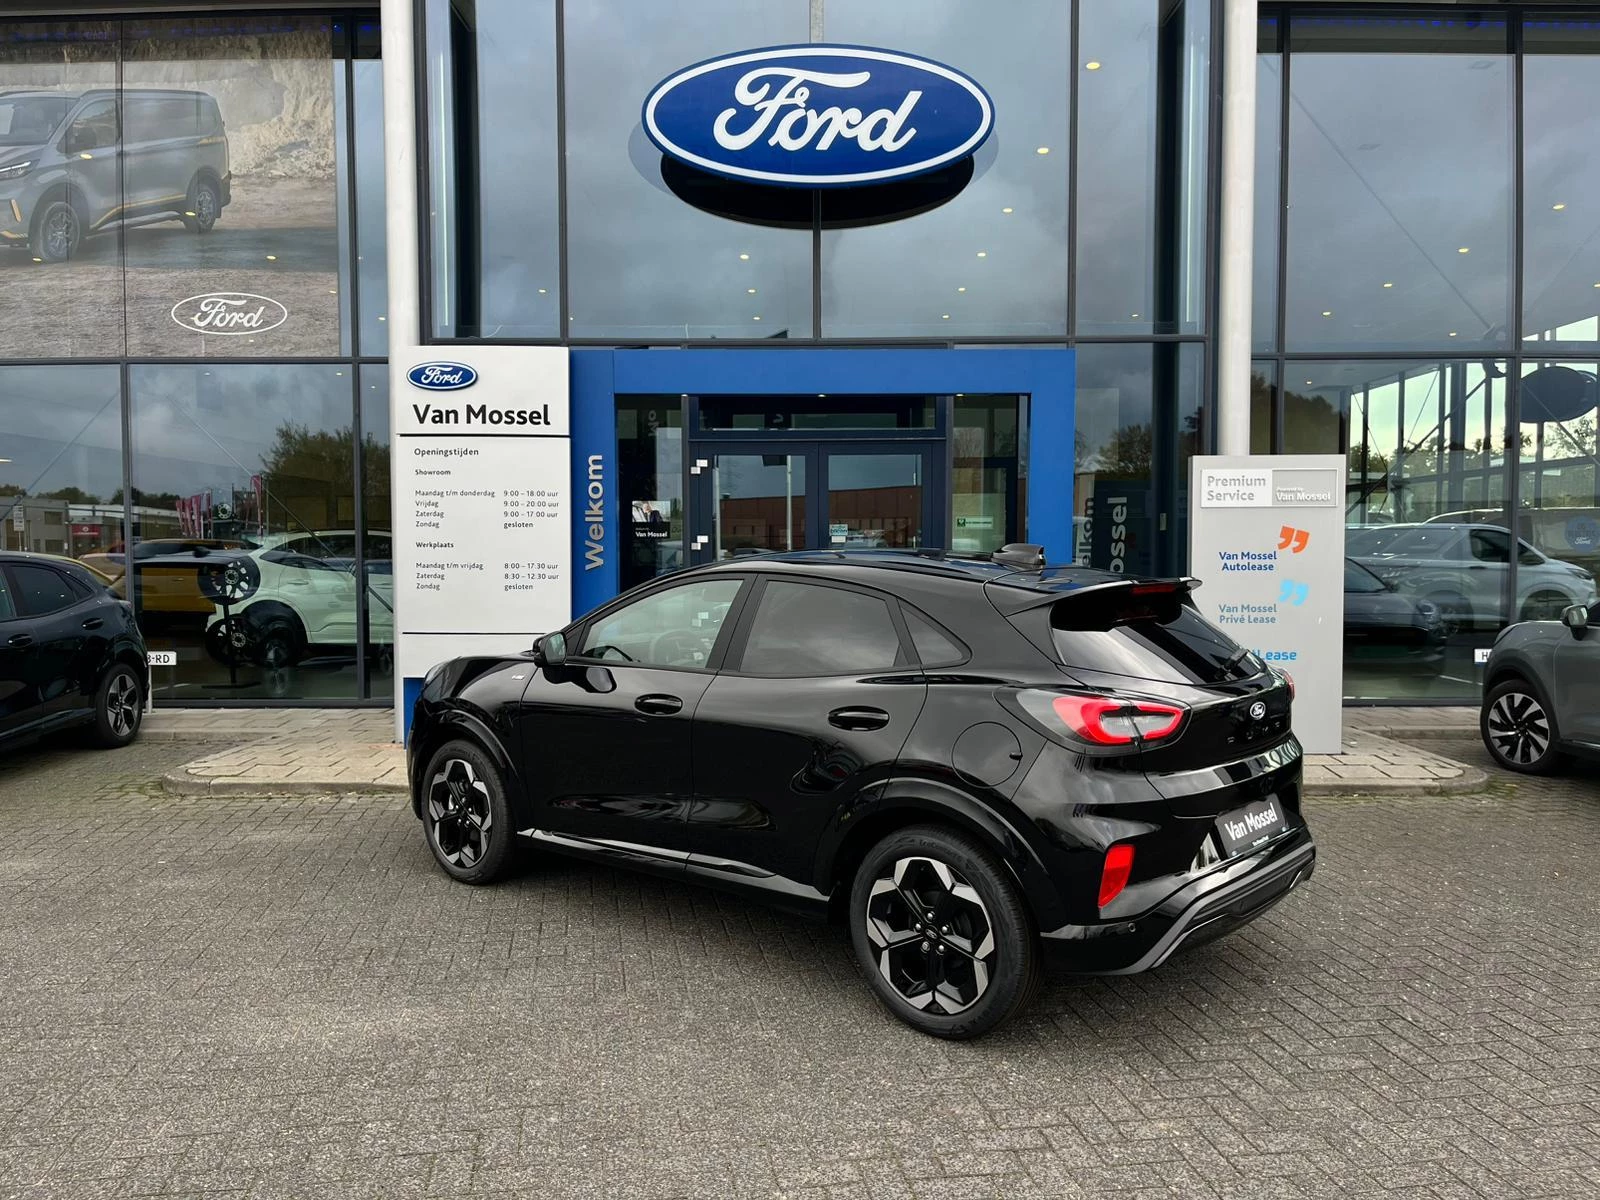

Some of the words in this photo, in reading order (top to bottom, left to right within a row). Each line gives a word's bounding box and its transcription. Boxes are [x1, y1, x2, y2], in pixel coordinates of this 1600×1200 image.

[713, 67, 923, 152] Ford
[193, 298, 265, 328] Ford
[420, 366, 463, 384] Ford
[412, 404, 458, 424] Van
[466, 404, 551, 425] Mossel
[414, 448, 480, 458] Openingstijden
[1207, 475, 1266, 487] Premium
[415, 489, 444, 498] Maandag
[460, 490, 495, 498] donderdag
[1207, 490, 1255, 501] Service
[1276, 492, 1294, 501] Van
[1297, 491, 1331, 502] Mossel
[415, 500, 439, 508] Vrijdag
[416, 510, 444, 519] Zaterdag
[585, 455, 604, 571] Welkom
[416, 521, 440, 529] Zondag
[504, 521, 533, 529] gesloten
[1107, 496, 1127, 573] ossel
[416, 541, 455, 550] Werkplaats
[1219, 551, 1238, 560] Van
[1241, 551, 1277, 561] Mossel
[416, 561, 445, 571] Maandag
[460, 562, 484, 570] vrijdag
[1222, 562, 1274, 571] Autolease
[416, 572, 445, 581] Zaterdag
[416, 583, 440, 592] Zondag
[504, 583, 533, 592] gesloten
[1219, 604, 1238, 613] Van
[1241, 604, 1277, 613] Mossel
[1219, 615, 1245, 624] Privé
[1248, 615, 1276, 624] Lease
[1225, 820, 1248, 841] Van
[1244, 802, 1278, 836] Mossel
